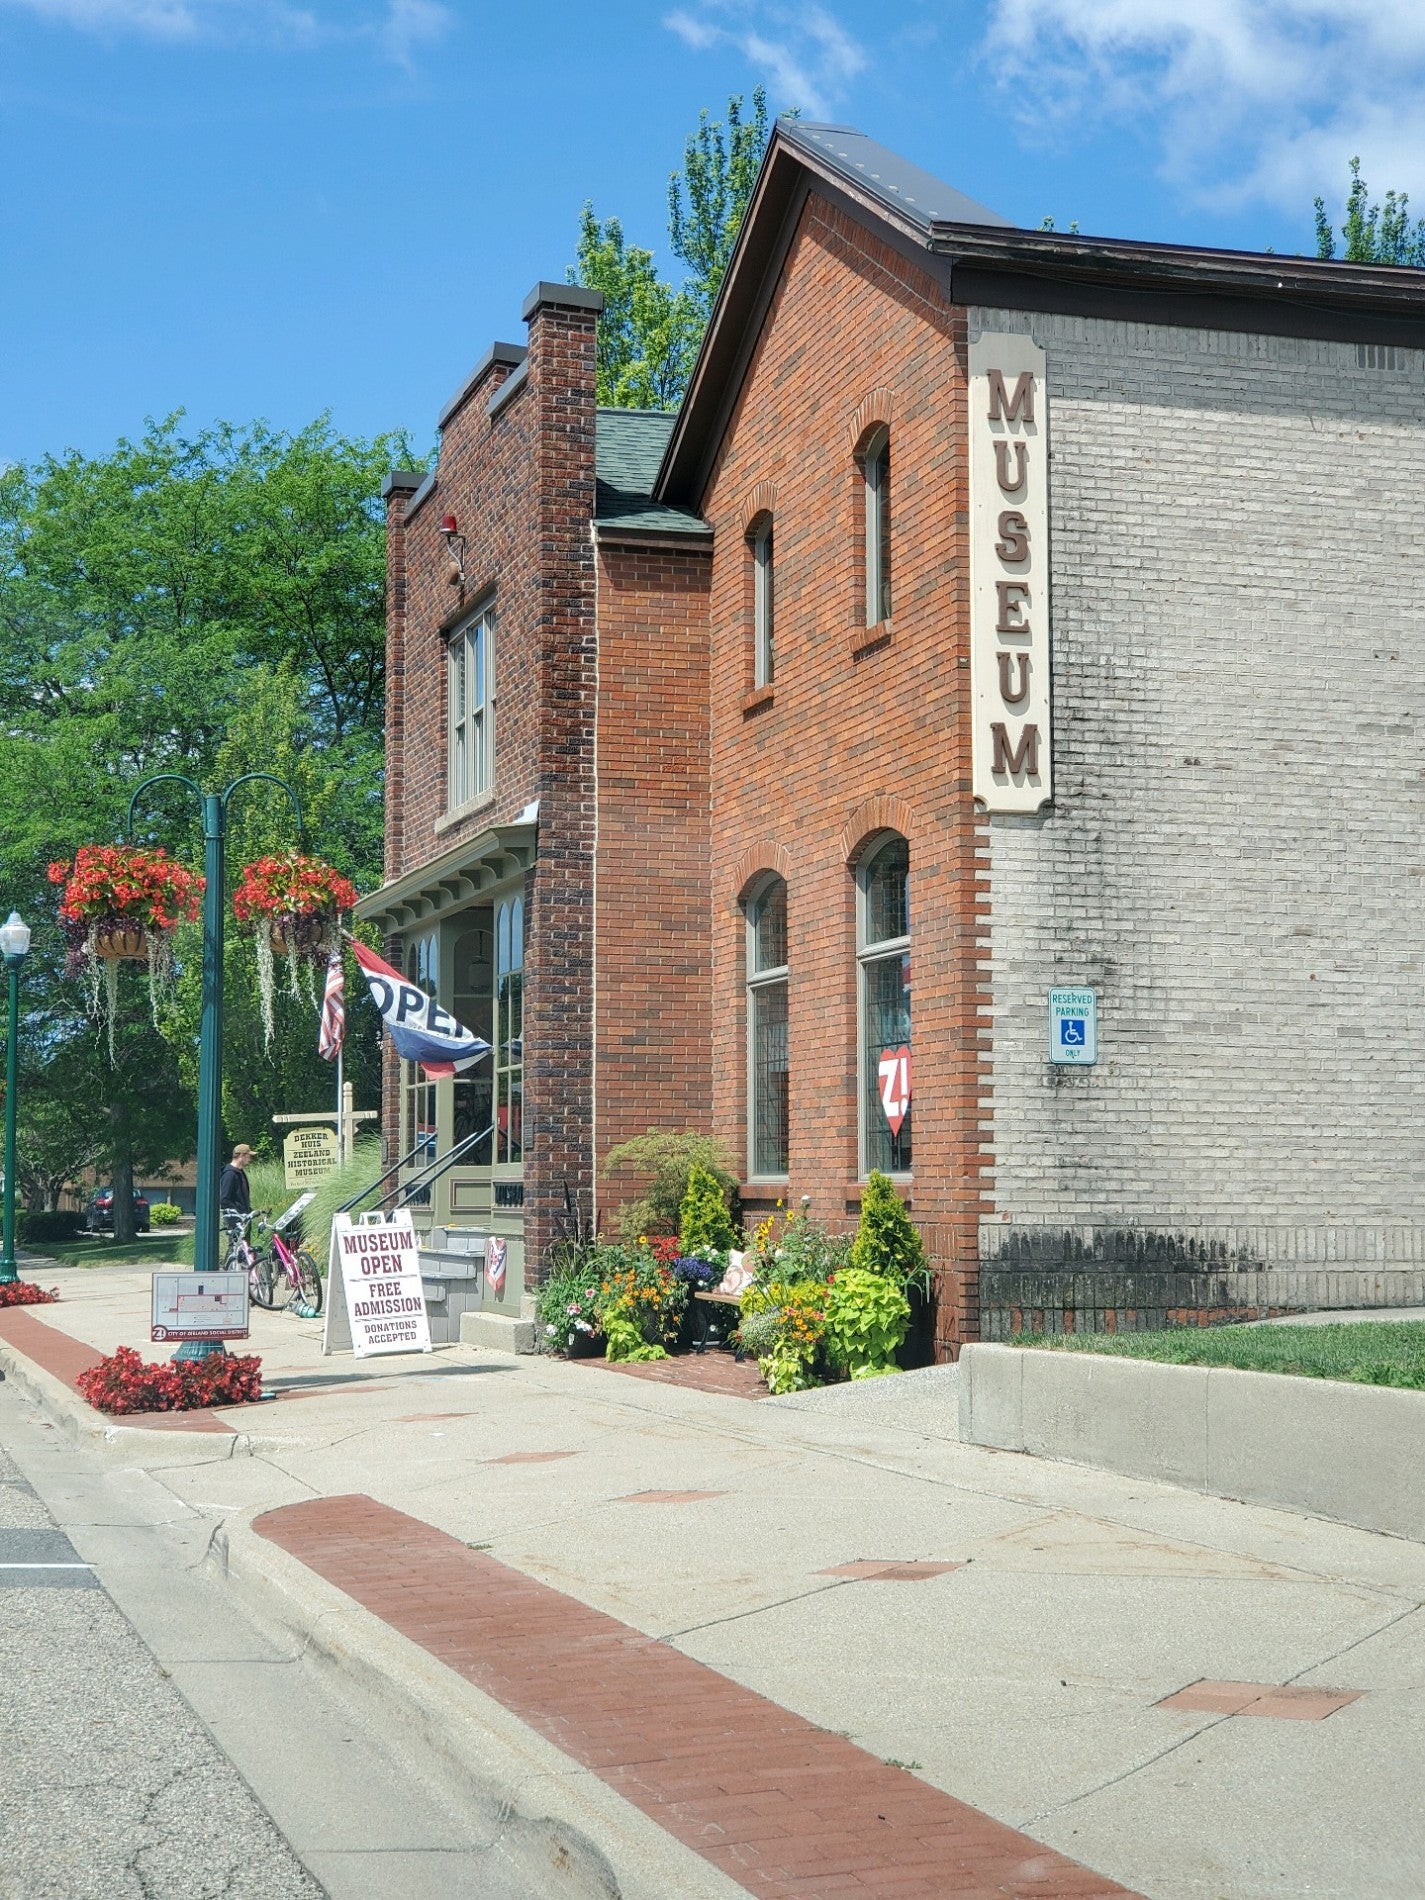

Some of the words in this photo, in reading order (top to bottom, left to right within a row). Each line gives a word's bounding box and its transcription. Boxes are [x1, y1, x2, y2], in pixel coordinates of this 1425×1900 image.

[986, 368, 1039, 775] MUSEUM
[1053, 994, 1092, 1004] RESERVED
[1056, 1007, 1089, 1016] PARKING
[879, 1058, 908, 1116] Z!
[294, 1133, 328, 1142] DEKKER
[293, 1150, 331, 1158] ZEELAND
[288, 1158, 337, 1168] HISTORICAL
[343, 1231, 413, 1254] MUSEUM
[361, 1254, 403, 1275] OPEN
[369, 1282, 402, 1298] FREE
[354, 1297, 422, 1316] ADMISSION
[364, 1320, 417, 1333] DONATIONS
[368, 1331, 417, 1344] ACCEPTED
